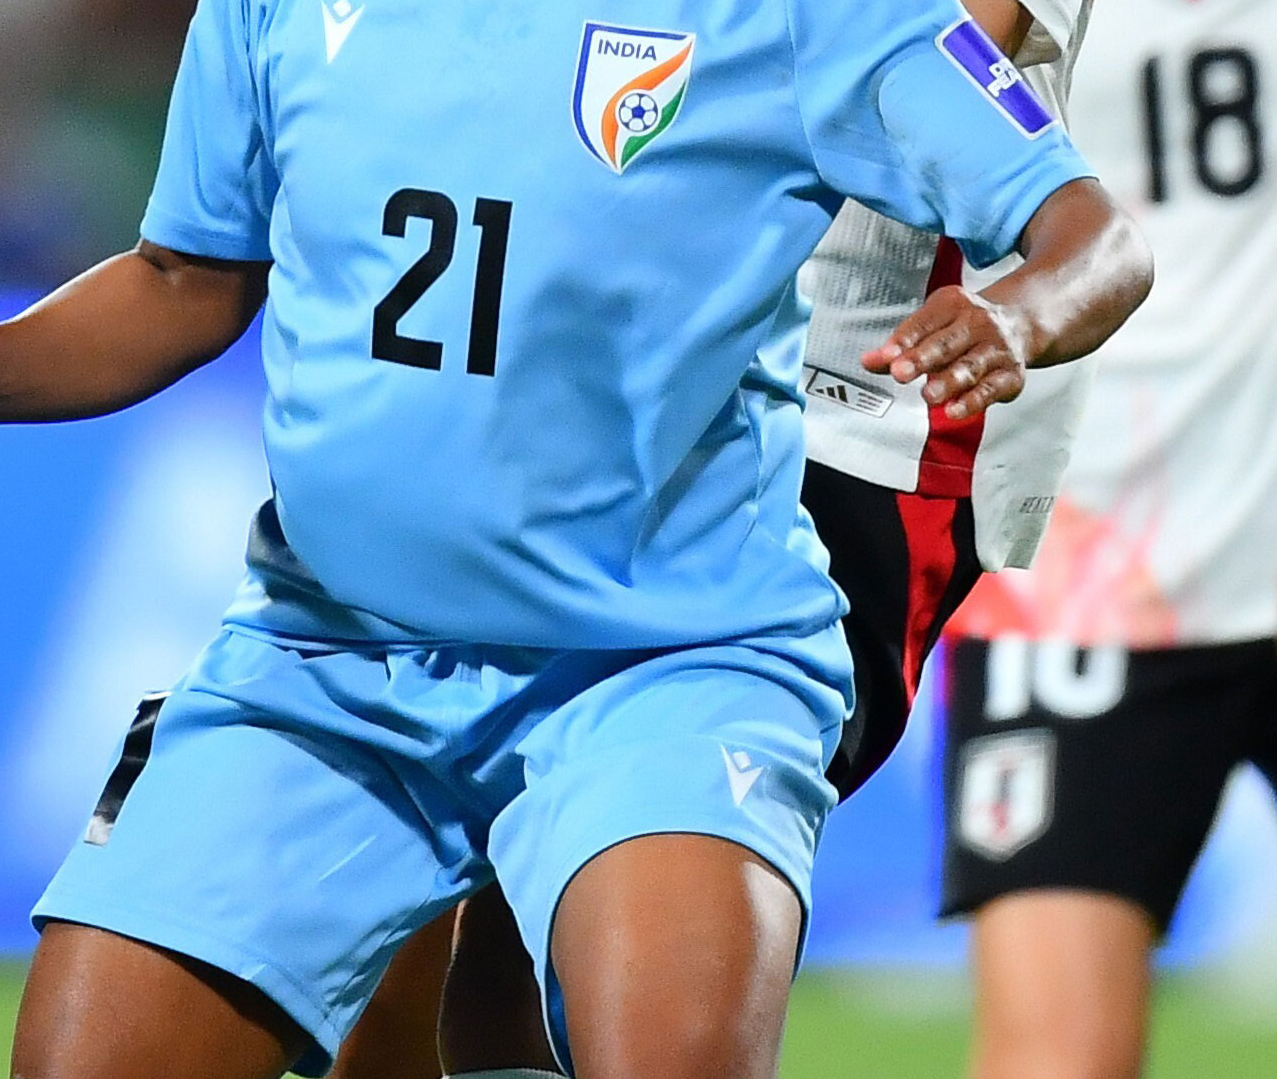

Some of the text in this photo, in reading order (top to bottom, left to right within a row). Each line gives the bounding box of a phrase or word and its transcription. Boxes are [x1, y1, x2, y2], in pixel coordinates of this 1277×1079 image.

[597, 39, 657, 61] INDIA
[1139, 46, 1263, 204] 18
[372, 188, 513, 377] 21
